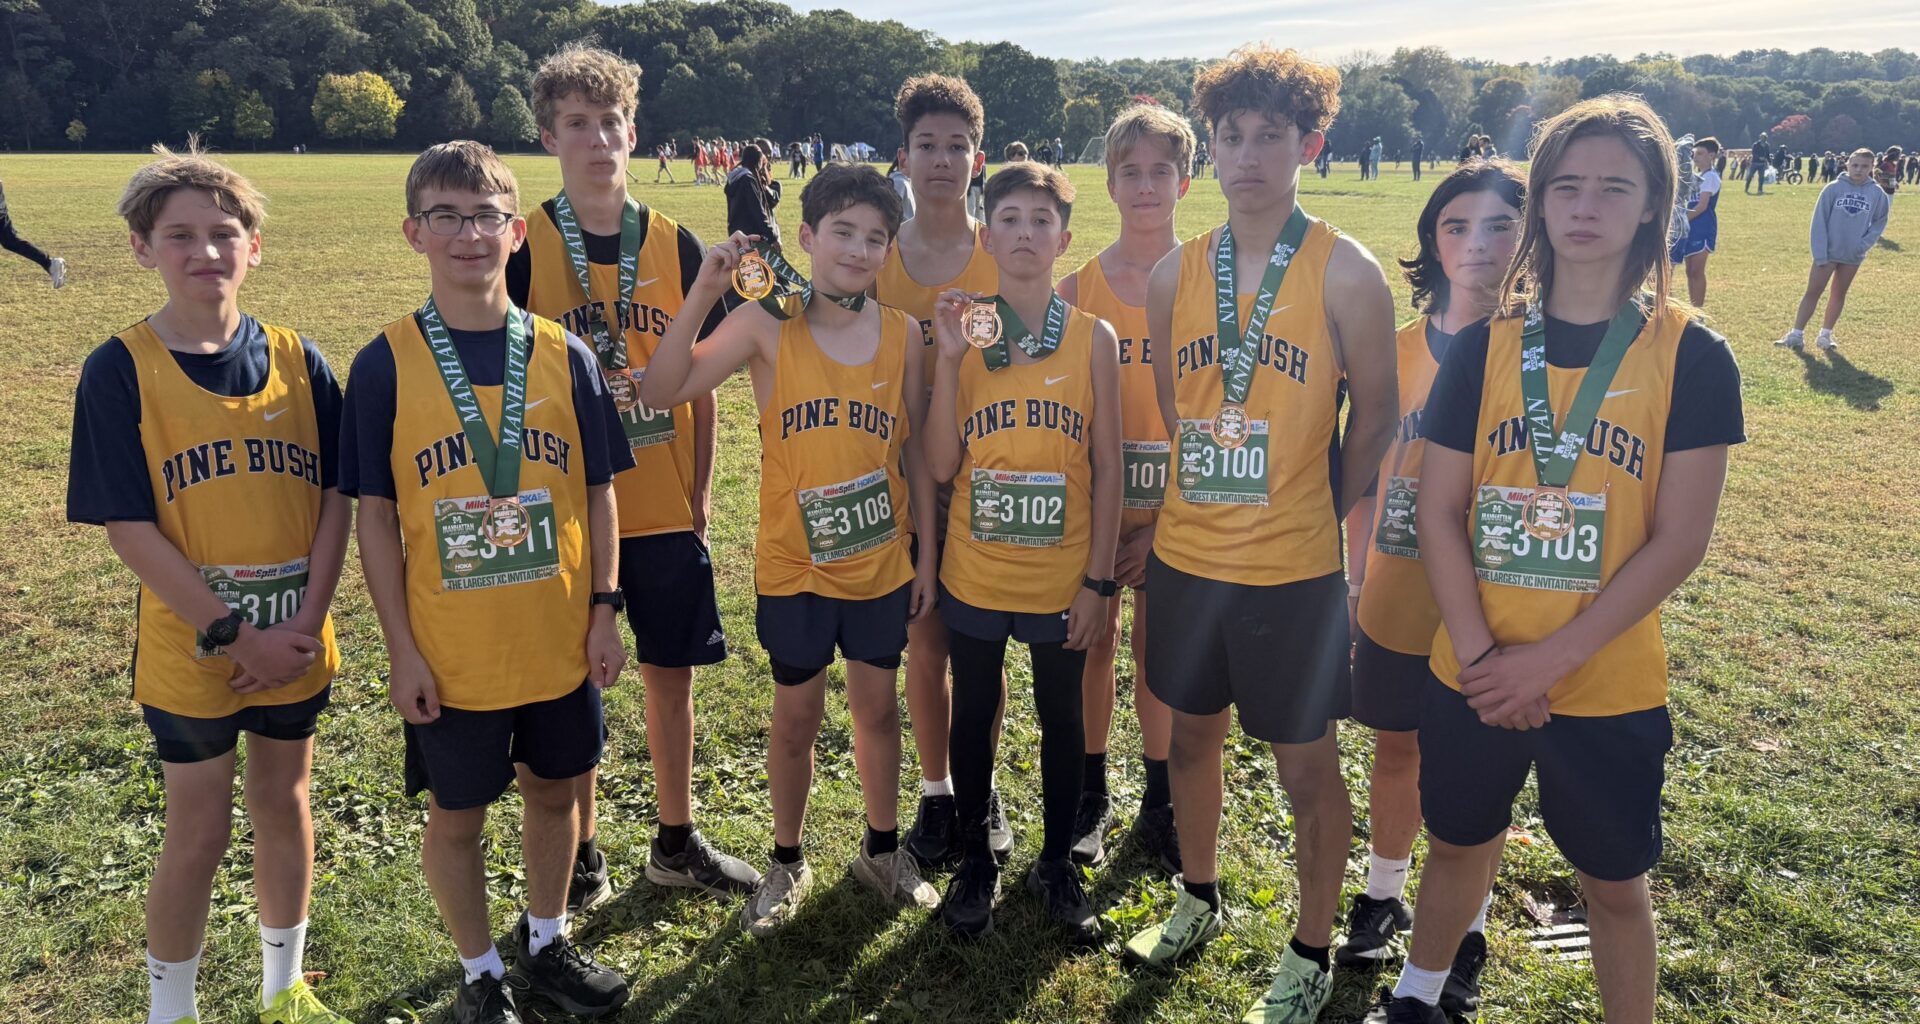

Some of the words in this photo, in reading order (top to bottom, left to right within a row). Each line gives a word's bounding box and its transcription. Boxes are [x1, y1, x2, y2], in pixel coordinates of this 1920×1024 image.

[1836, 198, 1870, 211] CADETS
[554, 302, 607, 338] INE
[613, 302, 673, 338] BUS
[422, 299, 482, 423] MANHATTAN
[1177, 333, 1222, 380] PIN
[502, 316, 526, 450] MANHATTAN
[780, 398, 839, 441] PINE
[963, 399, 1016, 449] PINE
[1025, 398, 1085, 445] BUSH
[1487, 415, 1529, 457] IN
[161, 438, 237, 504] PINE
[243, 438, 321, 487] BUSH
[414, 430, 478, 489] PIN
[1201, 445, 1265, 479] 3100
[823, 483, 856, 498] MileSplit
[857, 475, 876, 489] HOKA
[994, 473, 1028, 483] MileSplit
[1029, 475, 1052, 483] HOKA
[834, 491, 891, 536] 3108
[974, 499, 1000, 518] XC
[1000, 494, 1062, 525] 3102
[809, 516, 837, 538] XC
[1479, 525, 1512, 550] XC
[444, 534, 479, 560] XC
[814, 553, 828, 562] THE
[233, 567, 278, 580] MileSplit
[279, 562, 303, 576] HOKA
[448, 579, 463, 590] THE
[463, 575, 496, 588] LARGEST
[496, 573, 507, 584] XC
[1479, 569, 1490, 578] THE
[1491, 570, 1522, 583] LARGEST
[1522, 575, 1534, 586] XC
